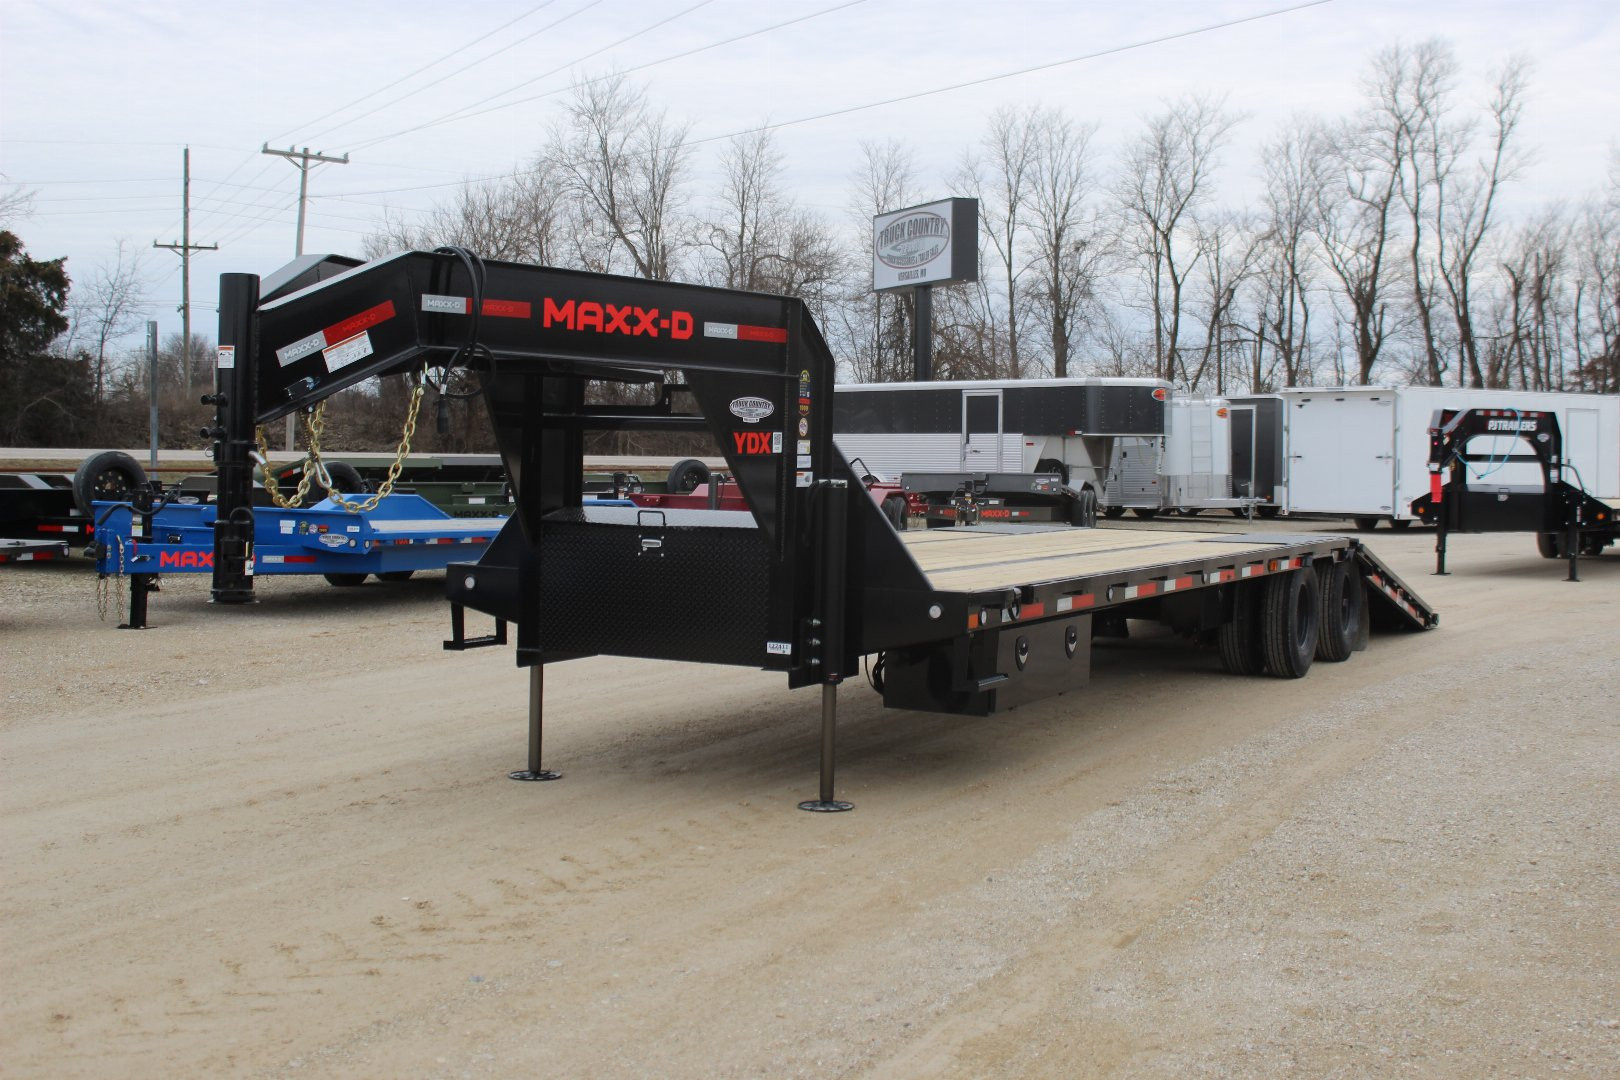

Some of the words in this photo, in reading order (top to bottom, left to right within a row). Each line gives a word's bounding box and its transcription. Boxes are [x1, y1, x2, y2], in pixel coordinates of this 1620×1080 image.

[880, 221, 906, 249] TRUCK
[907, 217, 946, 237] COUNTRY
[427, 299, 461, 309] MAXX-D
[543, 297, 694, 340] MAXX-D
[283, 339, 320, 360] MAXX-D
[733, 432, 772, 454] YDX
